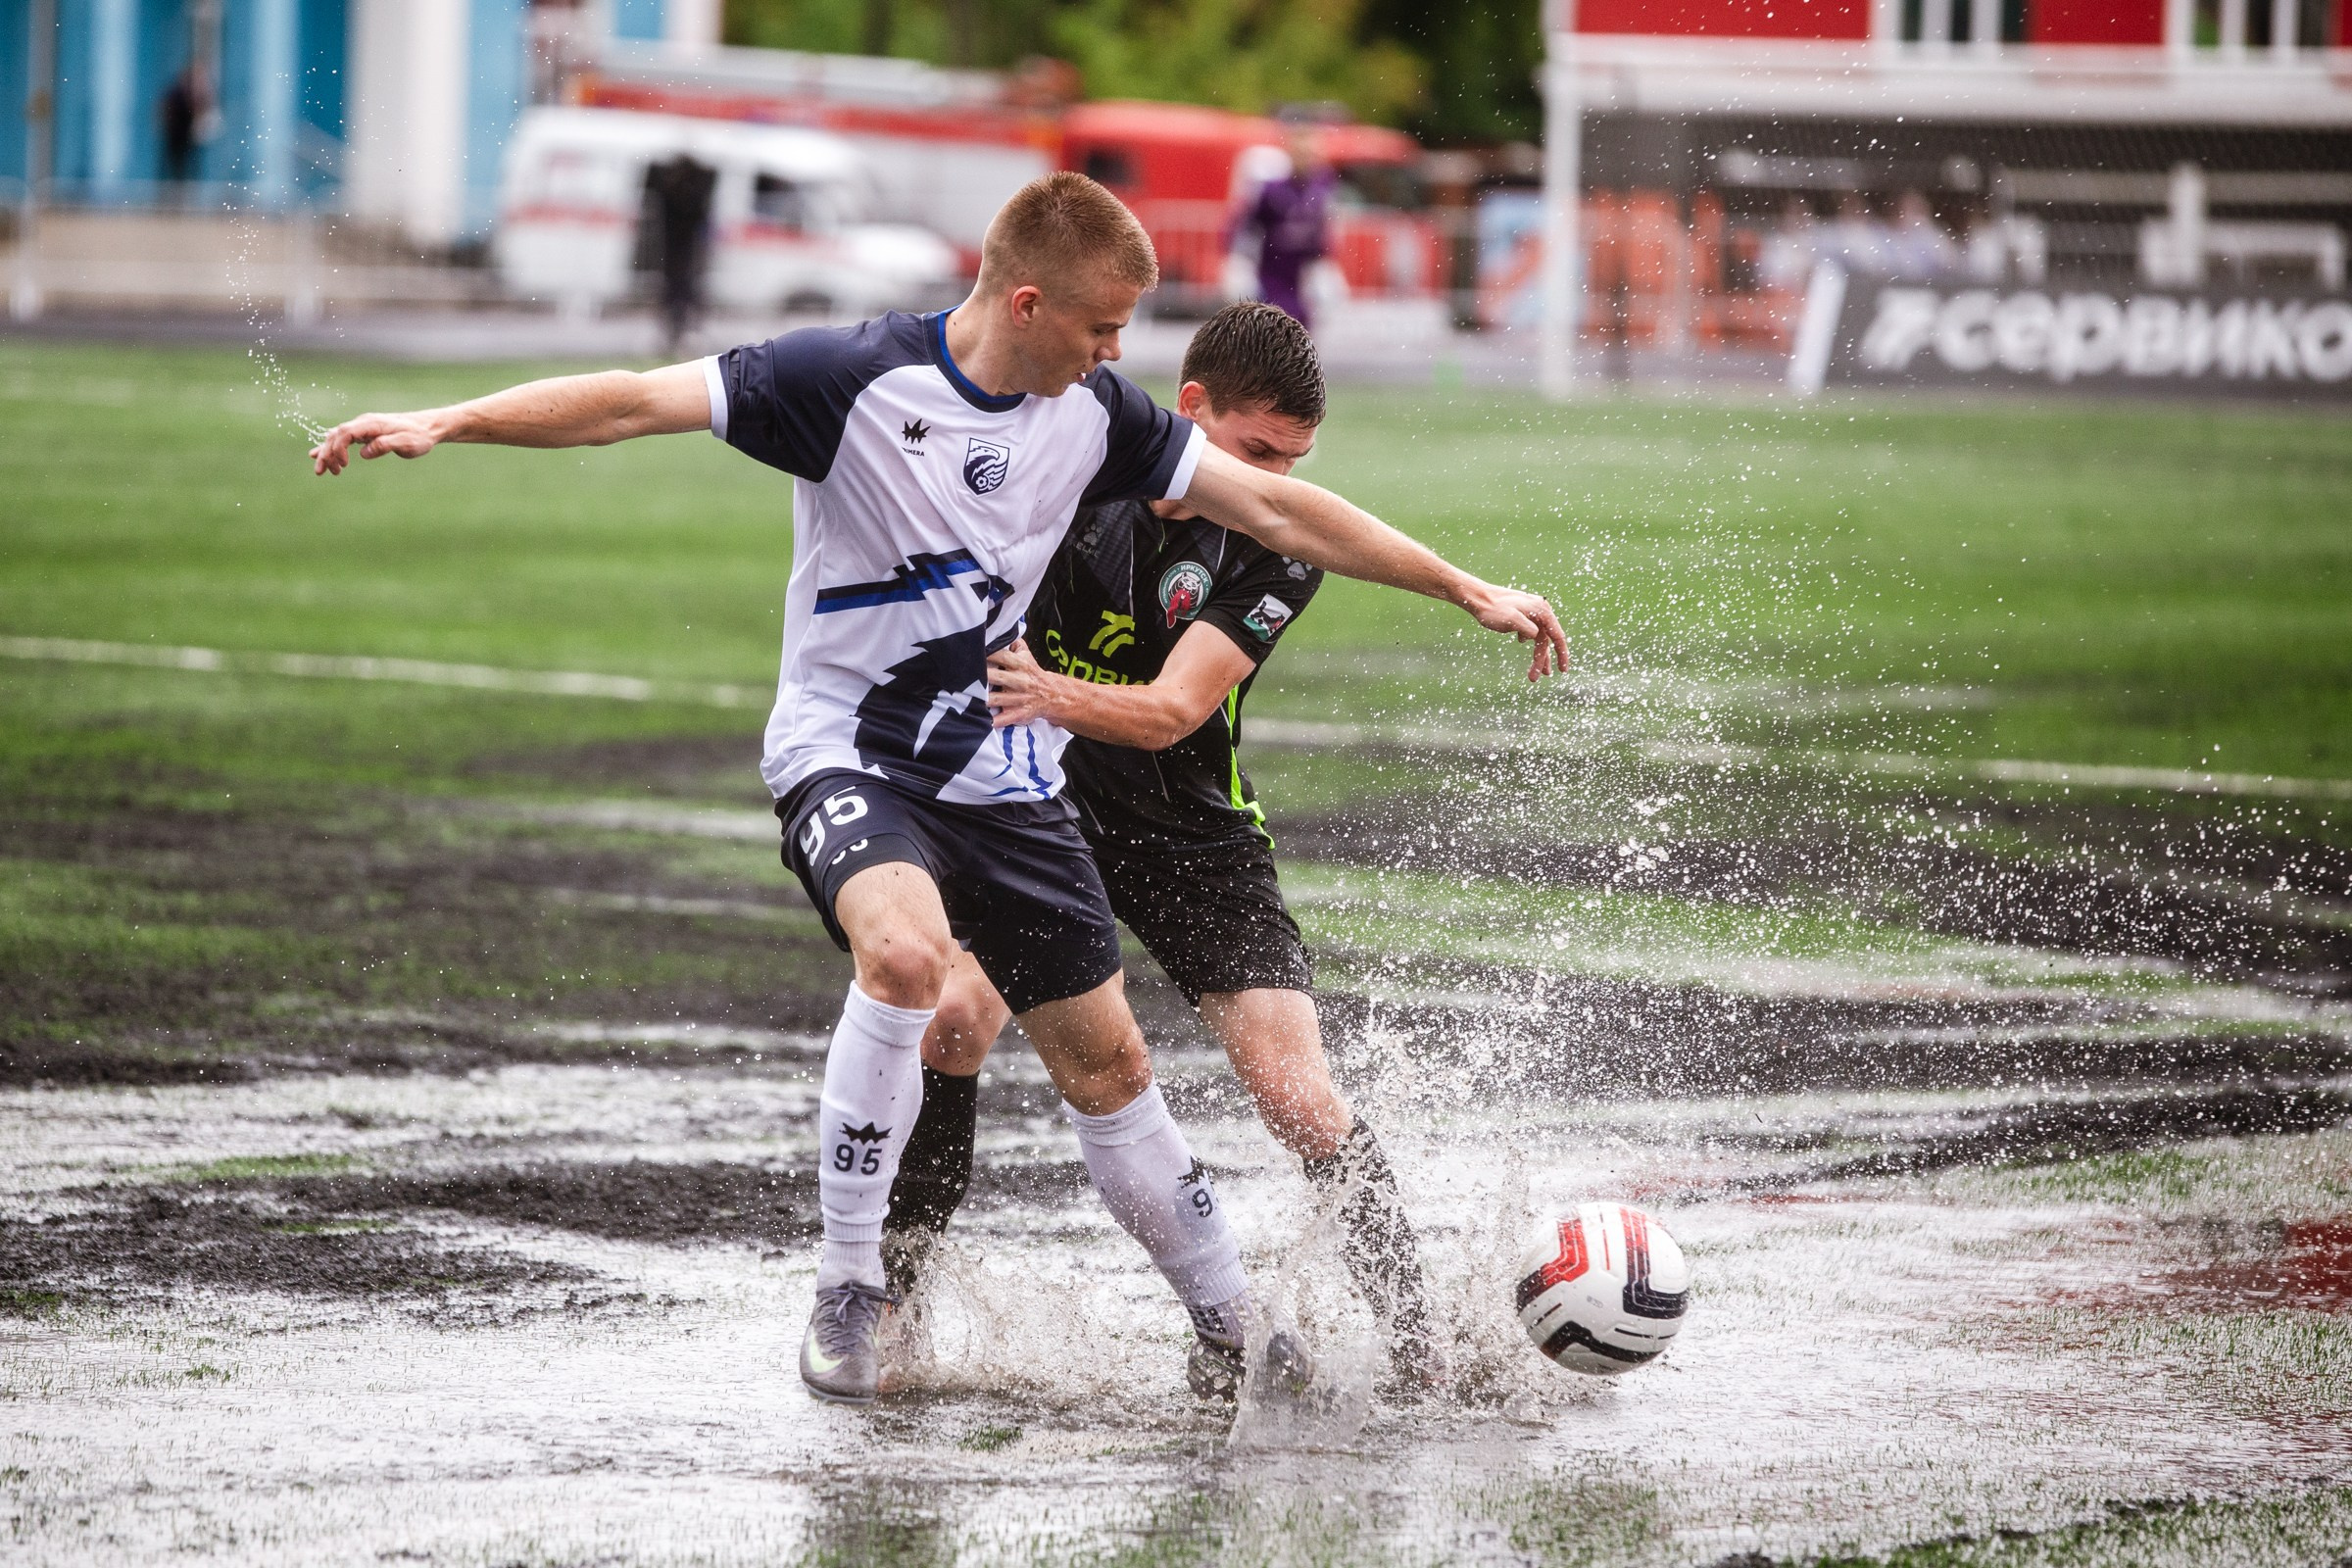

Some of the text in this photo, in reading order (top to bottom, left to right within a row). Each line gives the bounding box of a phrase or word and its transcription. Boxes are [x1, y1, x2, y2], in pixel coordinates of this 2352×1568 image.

[901, 446, 925, 457] IMERA
[1073, 541, 1101, 558] ELME
[1180, 564, 1208, 583] ИРКУТСК
[799, 786, 868, 866] 95
[833, 1144, 882, 1176] 95
[1192, 1188, 1215, 1218] 9
